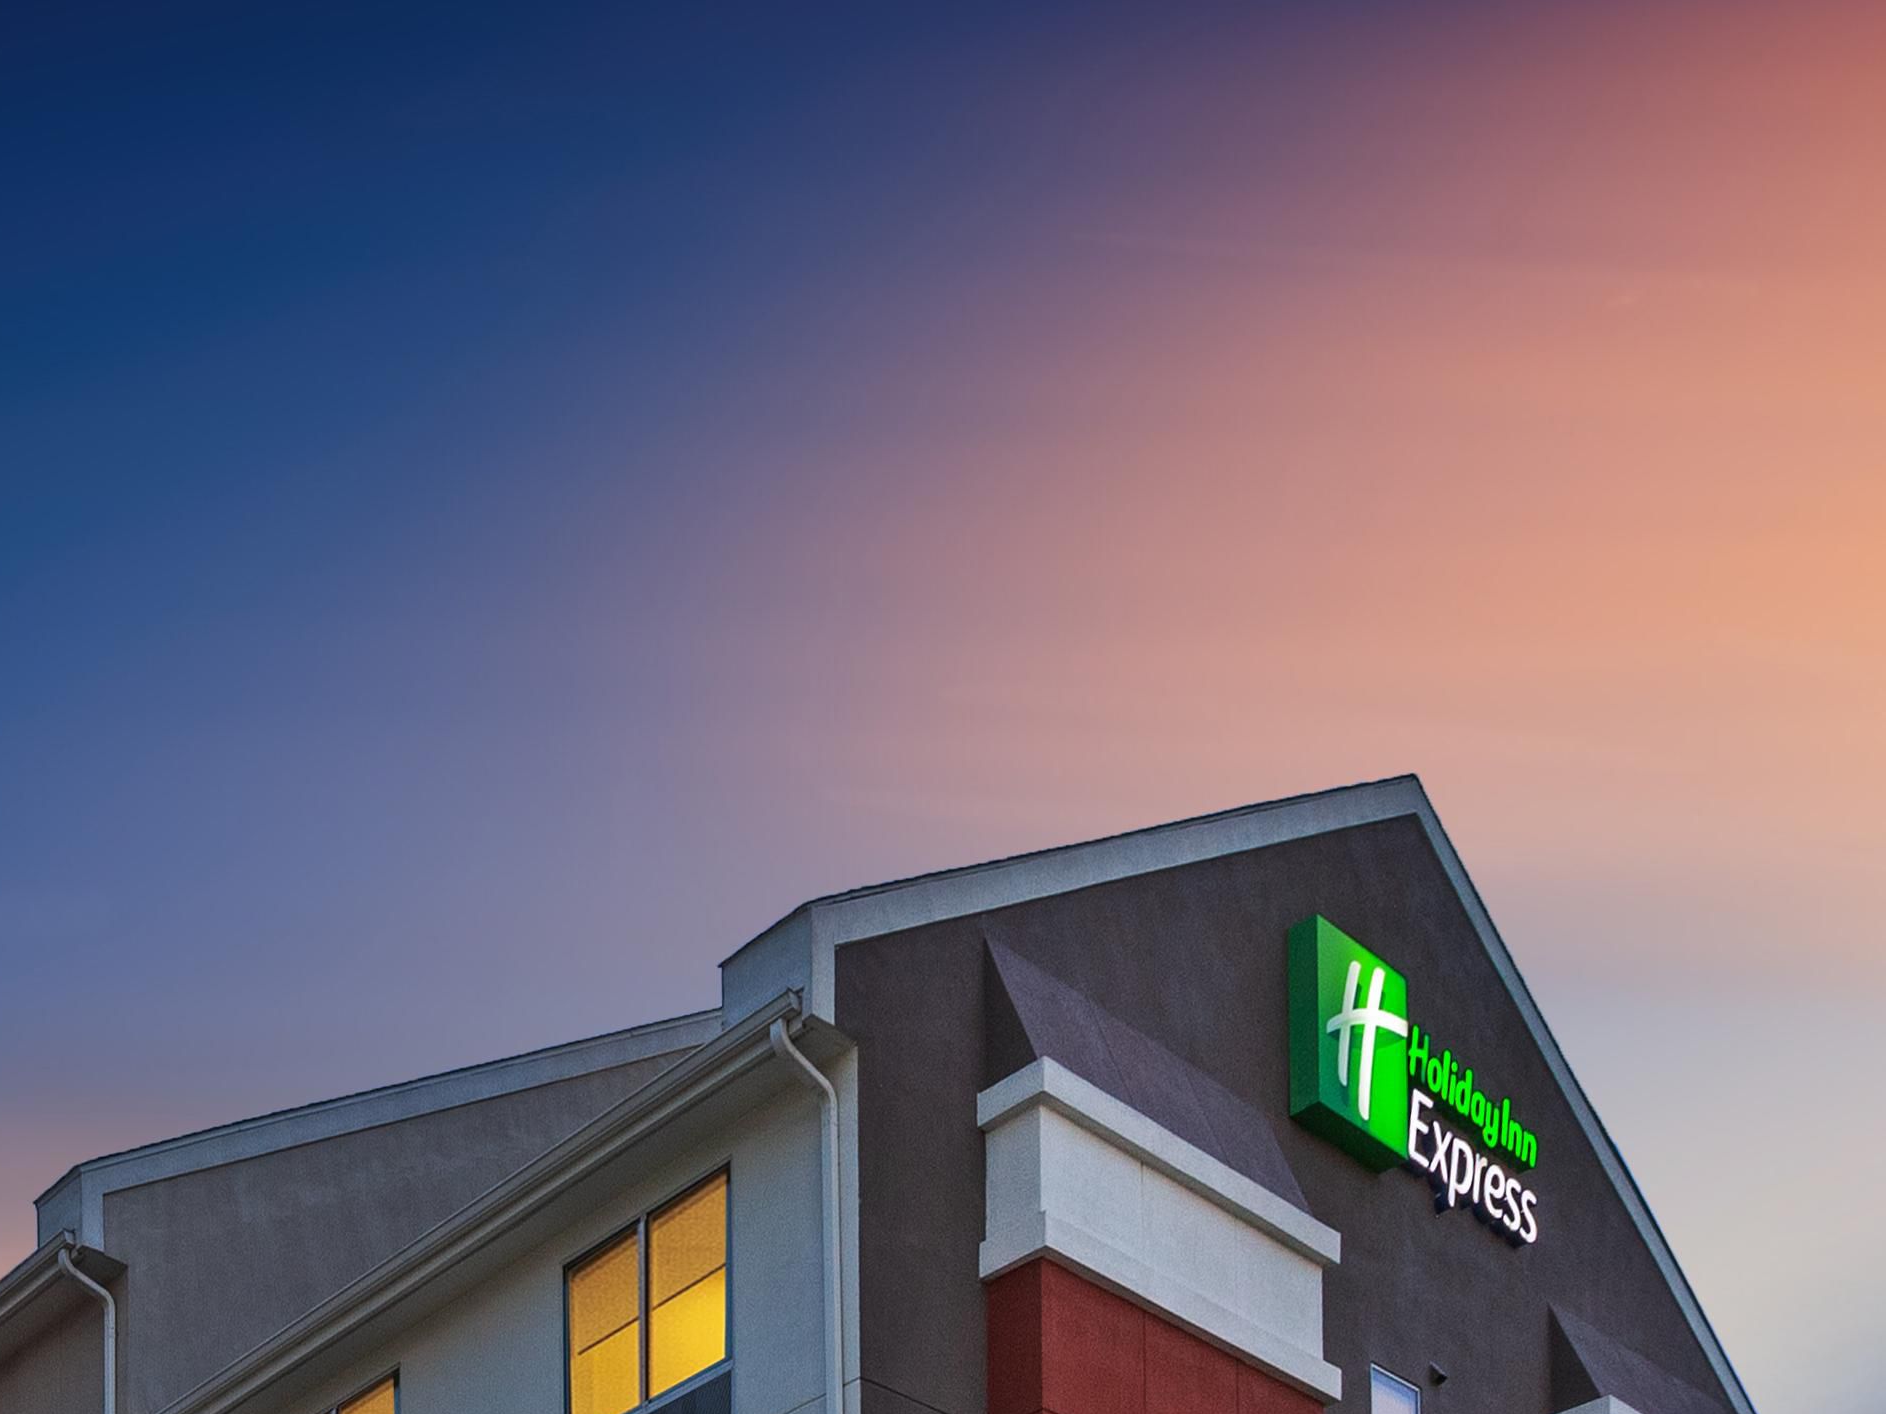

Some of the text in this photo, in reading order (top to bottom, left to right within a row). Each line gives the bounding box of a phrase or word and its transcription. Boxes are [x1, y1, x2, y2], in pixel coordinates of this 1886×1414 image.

[1326, 960, 1409, 1121] H
[1408, 1024, 1501, 1148] Holiday
[1408, 1088, 1539, 1244] Express
